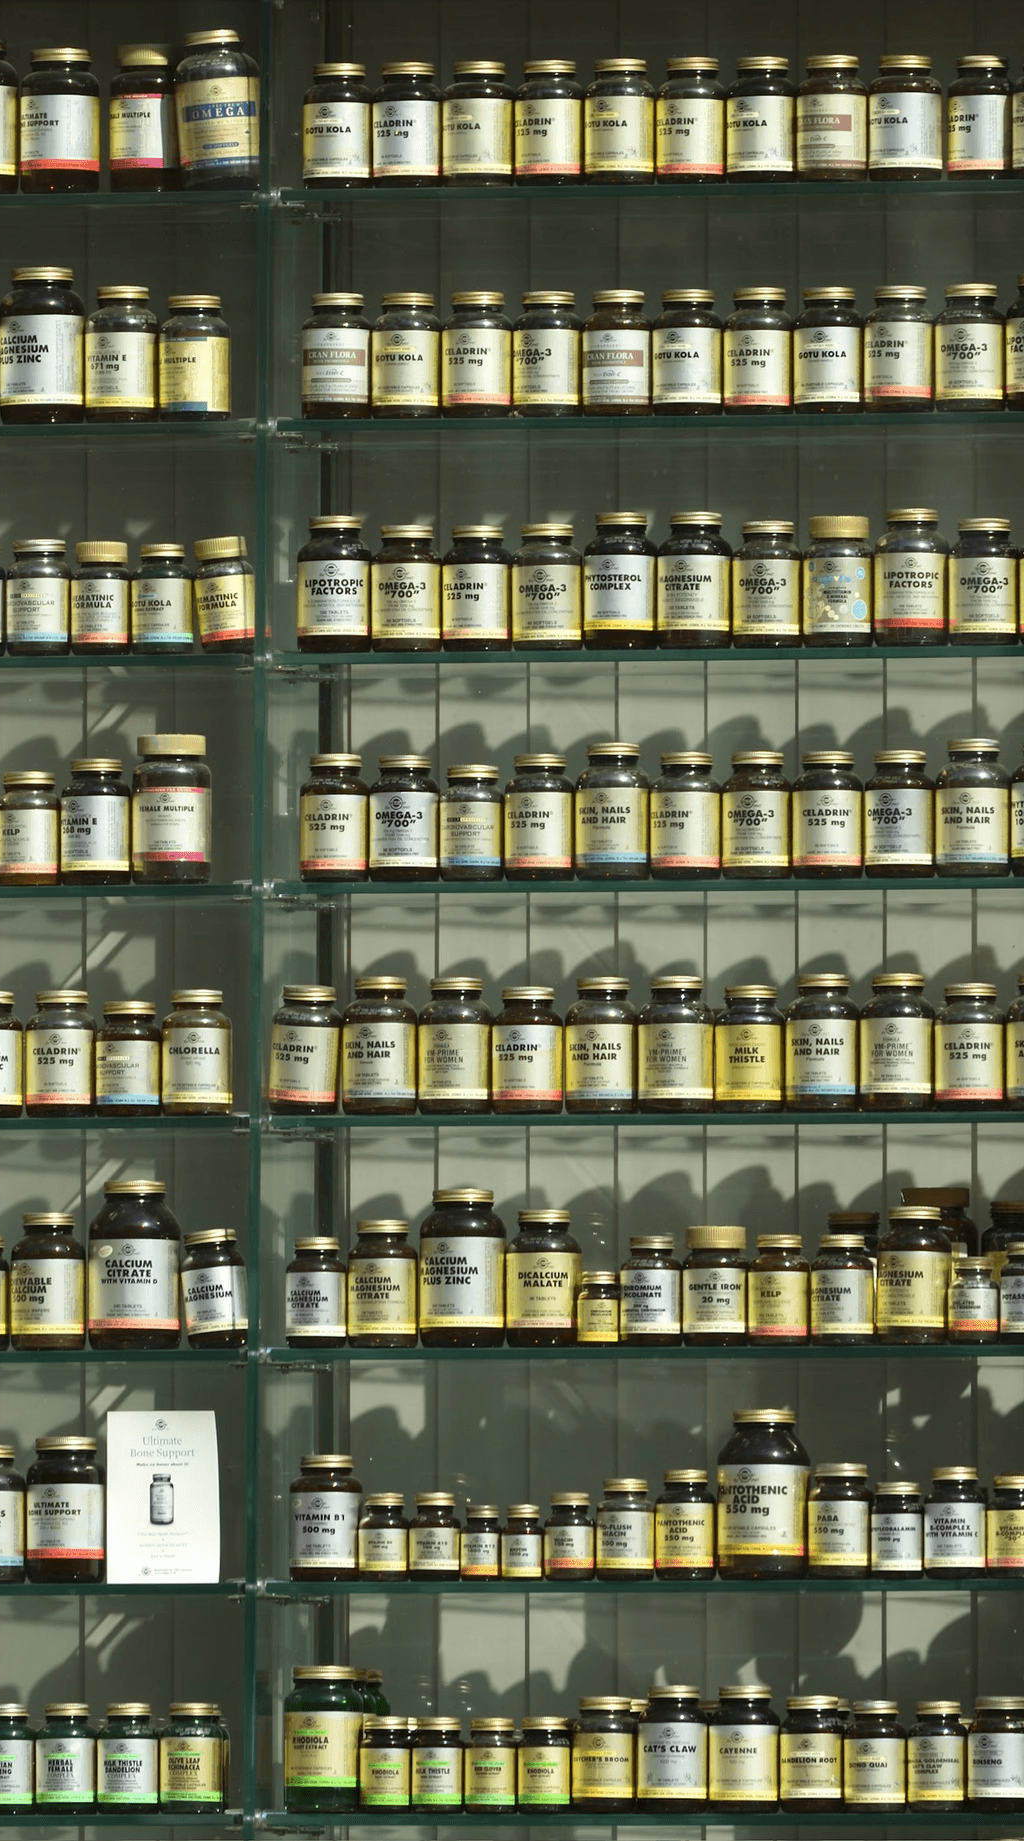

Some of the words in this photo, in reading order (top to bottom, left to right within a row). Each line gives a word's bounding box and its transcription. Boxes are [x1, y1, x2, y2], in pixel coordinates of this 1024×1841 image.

[192, 106, 245, 119] OMEGA
[27, 119, 59, 127] SUPPORT
[305, 126, 327, 134] GOTU
[329, 126, 351, 134] KOLA
[533, 128, 547, 136] mg
[940, 343, 987, 352] OMEGA-3
[87, 354, 119, 362] VITAMIN
[376, 354, 396, 362] GOTU
[448, 357, 466, 365] 525
[469, 358, 483, 366] mg
[305, 579, 364, 588] LIPOTROPIC
[378, 582, 426, 591] OMEGA-3
[590, 582, 631, 590] COMPLEX
[665, 583, 700, 591] CITRATE
[311, 587, 357, 596] FACTORS
[146, 599, 172, 607] KOLA
[375, 811, 423, 820] OMEGA-3
[944, 816, 962, 824] AND
[309, 823, 327, 831] 525
[330, 823, 345, 832] mg
[2, 828, 20, 836] KELP
[345, 1042, 365, 1050] SKIN,
[367, 1041, 395, 1049] NAILS
[169, 1047, 220, 1055] CHLORELLA
[794, 1048, 812, 1056] AND
[37, 1057, 57, 1065] 525
[59, 1057, 74, 1066] mg
[729, 1055, 765, 1063] THISTLE
[105, 1260, 153, 1269] CALCIUM
[106, 1269, 151, 1278] CITRATE
[518, 1271, 568, 1280] DICALCIUM
[523, 1280, 563, 1288] MALATE
[761, 1290, 782, 1298] KELP
[142, 1436, 182, 1446] Ultimate
[130, 1448, 154, 1458] Bone
[156, 1448, 195, 1460] Support
[302, 1526, 319, 1534] 500
[321, 1527, 335, 1535] mg
[643, 1745, 666, 1753] CAT'S
[669, 1745, 696, 1753] CLAW
